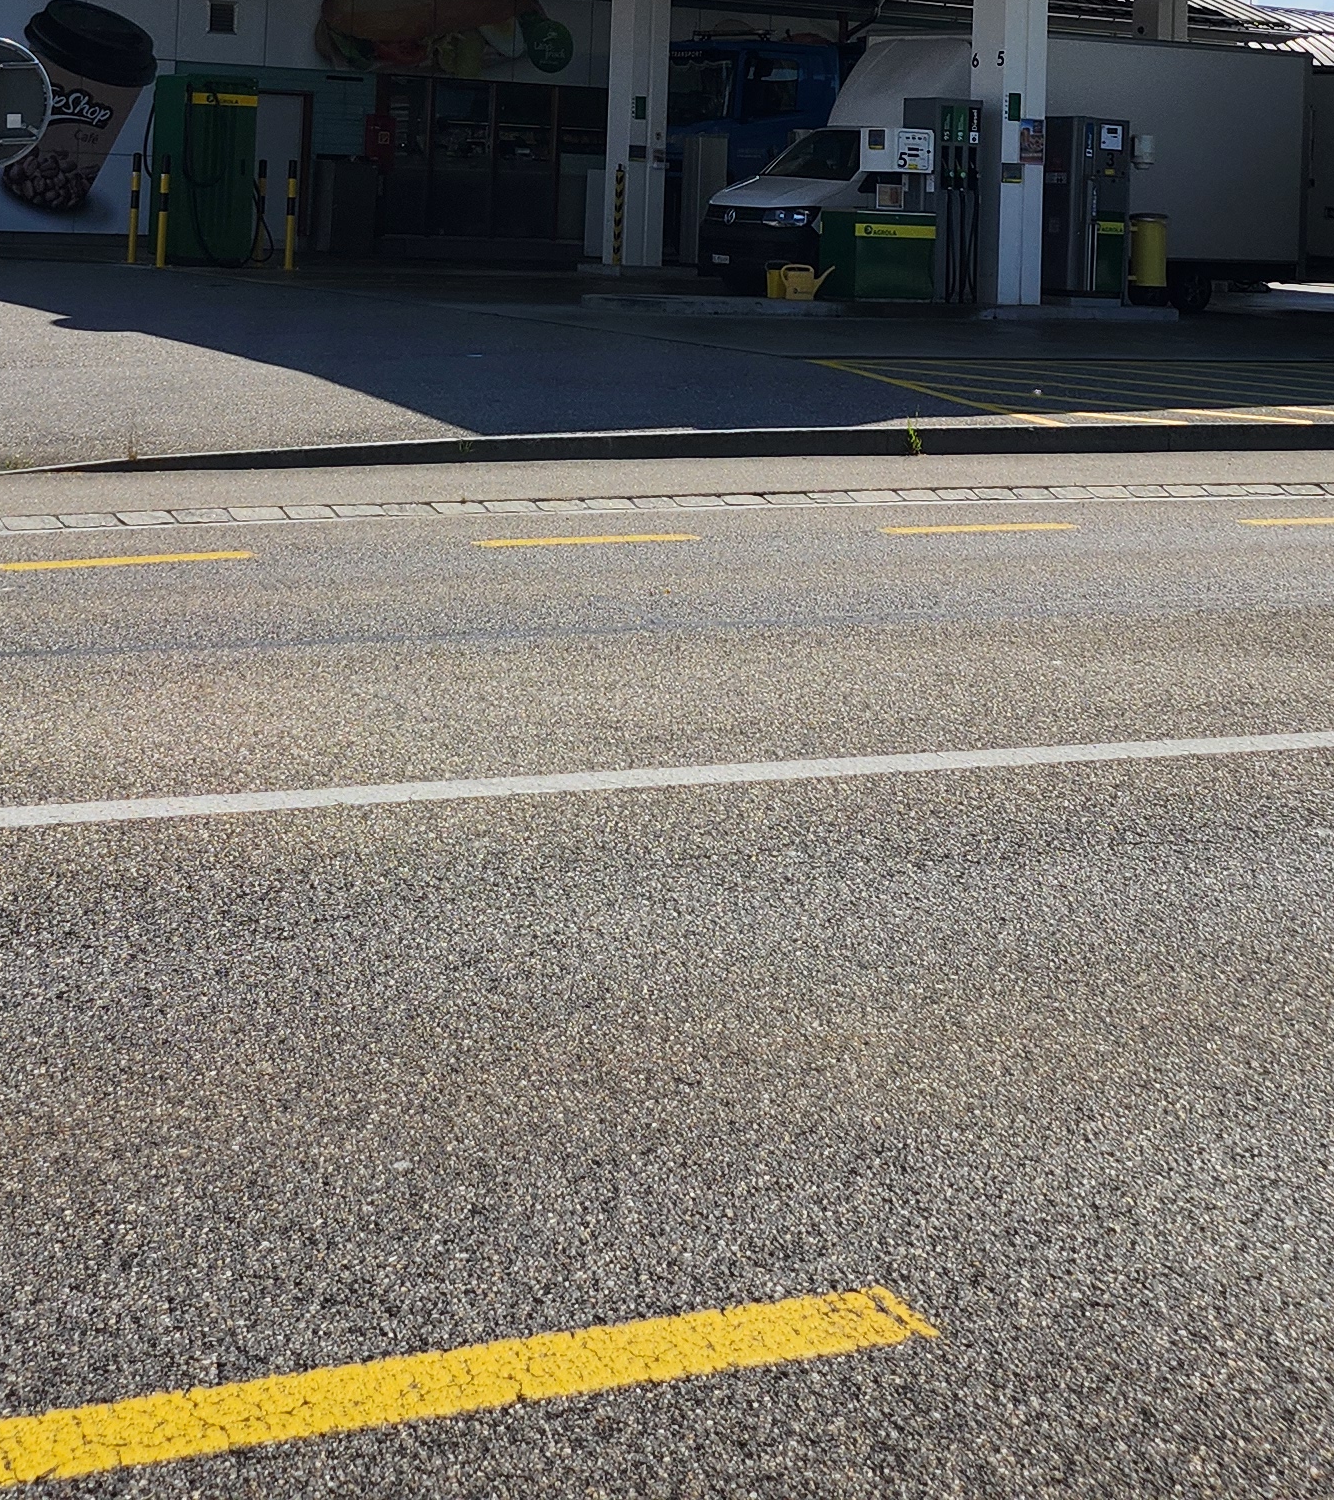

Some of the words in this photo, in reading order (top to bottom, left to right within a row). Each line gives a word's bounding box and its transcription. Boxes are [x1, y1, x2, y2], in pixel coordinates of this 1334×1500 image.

[971, 52, 979, 69] 6
[997, 50, 1005, 67] 5
[51, 86, 112, 126] pShop
[943, 130, 951, 141] 95
[957, 131, 964, 142] 98
[898, 152, 908, 168] 5
[1106, 152, 1115, 167] 3
